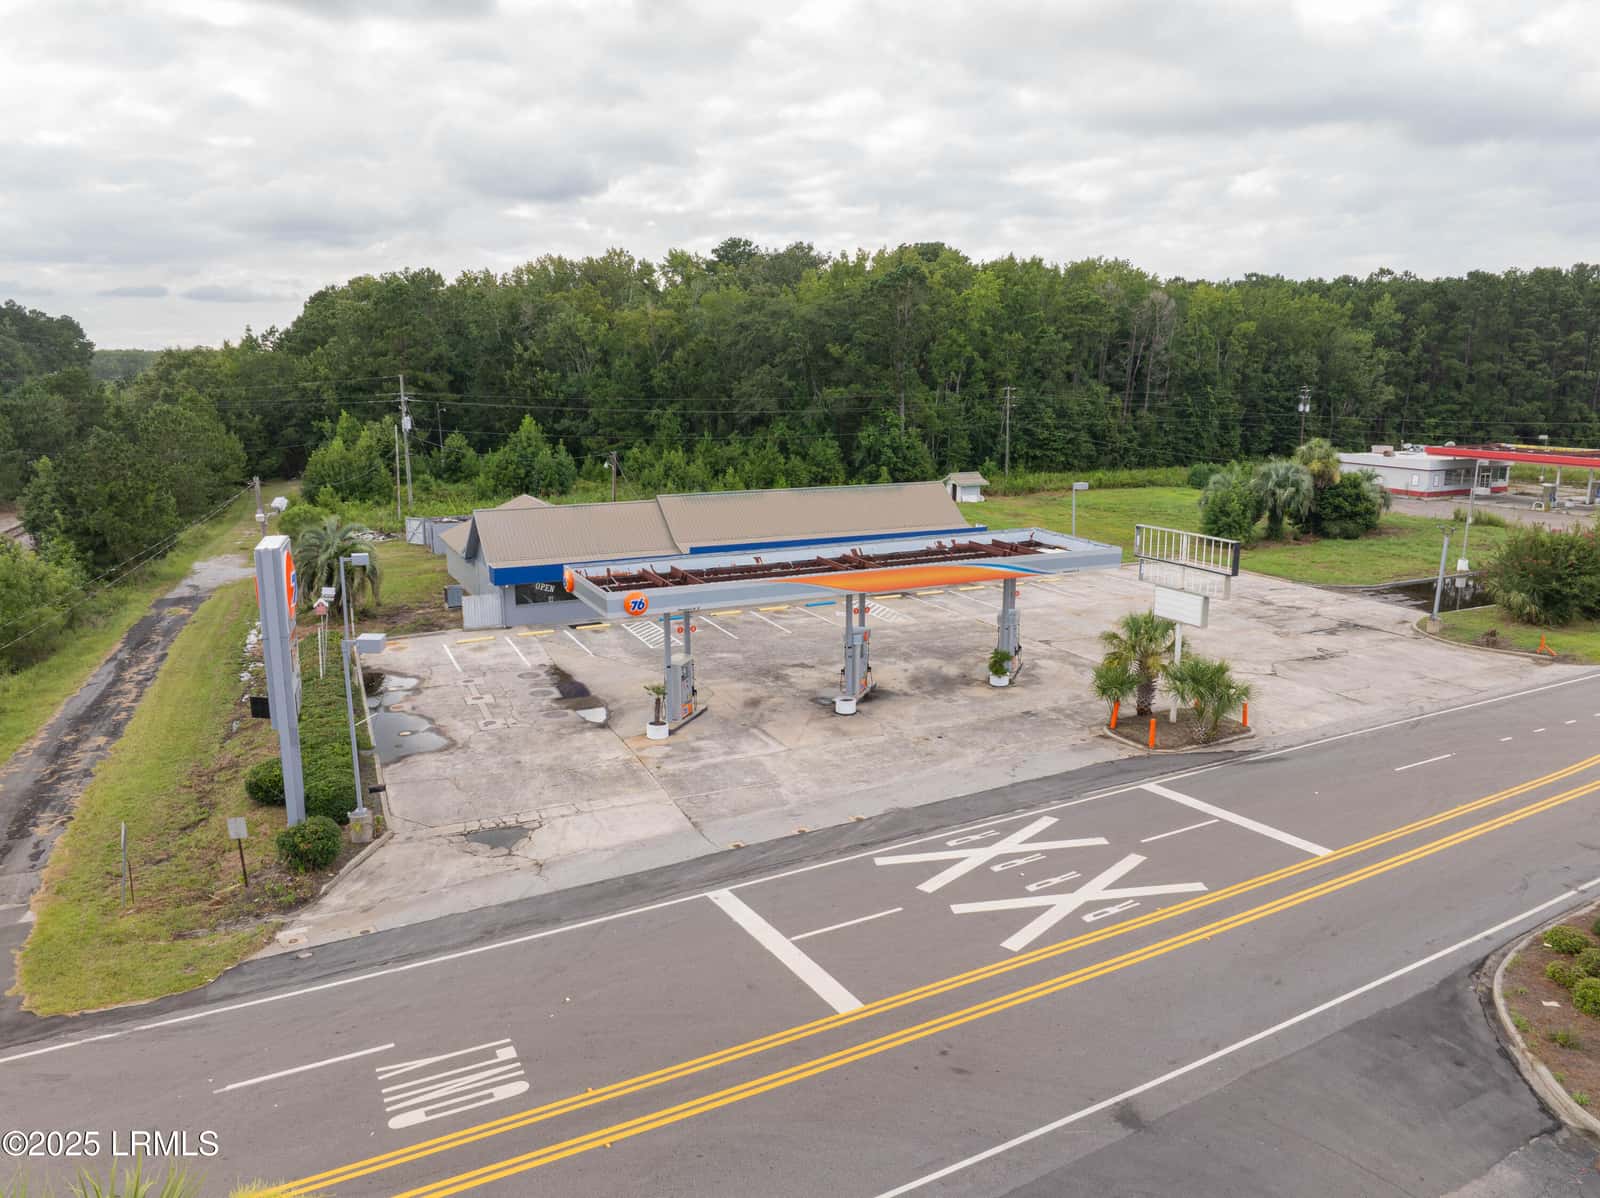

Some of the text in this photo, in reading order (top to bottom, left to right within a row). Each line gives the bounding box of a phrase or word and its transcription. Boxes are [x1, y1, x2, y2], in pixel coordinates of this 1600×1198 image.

[535, 583, 555, 593] OPEN
[630, 596, 646, 611] 76
[375, 1037, 531, 1130] ONLY
